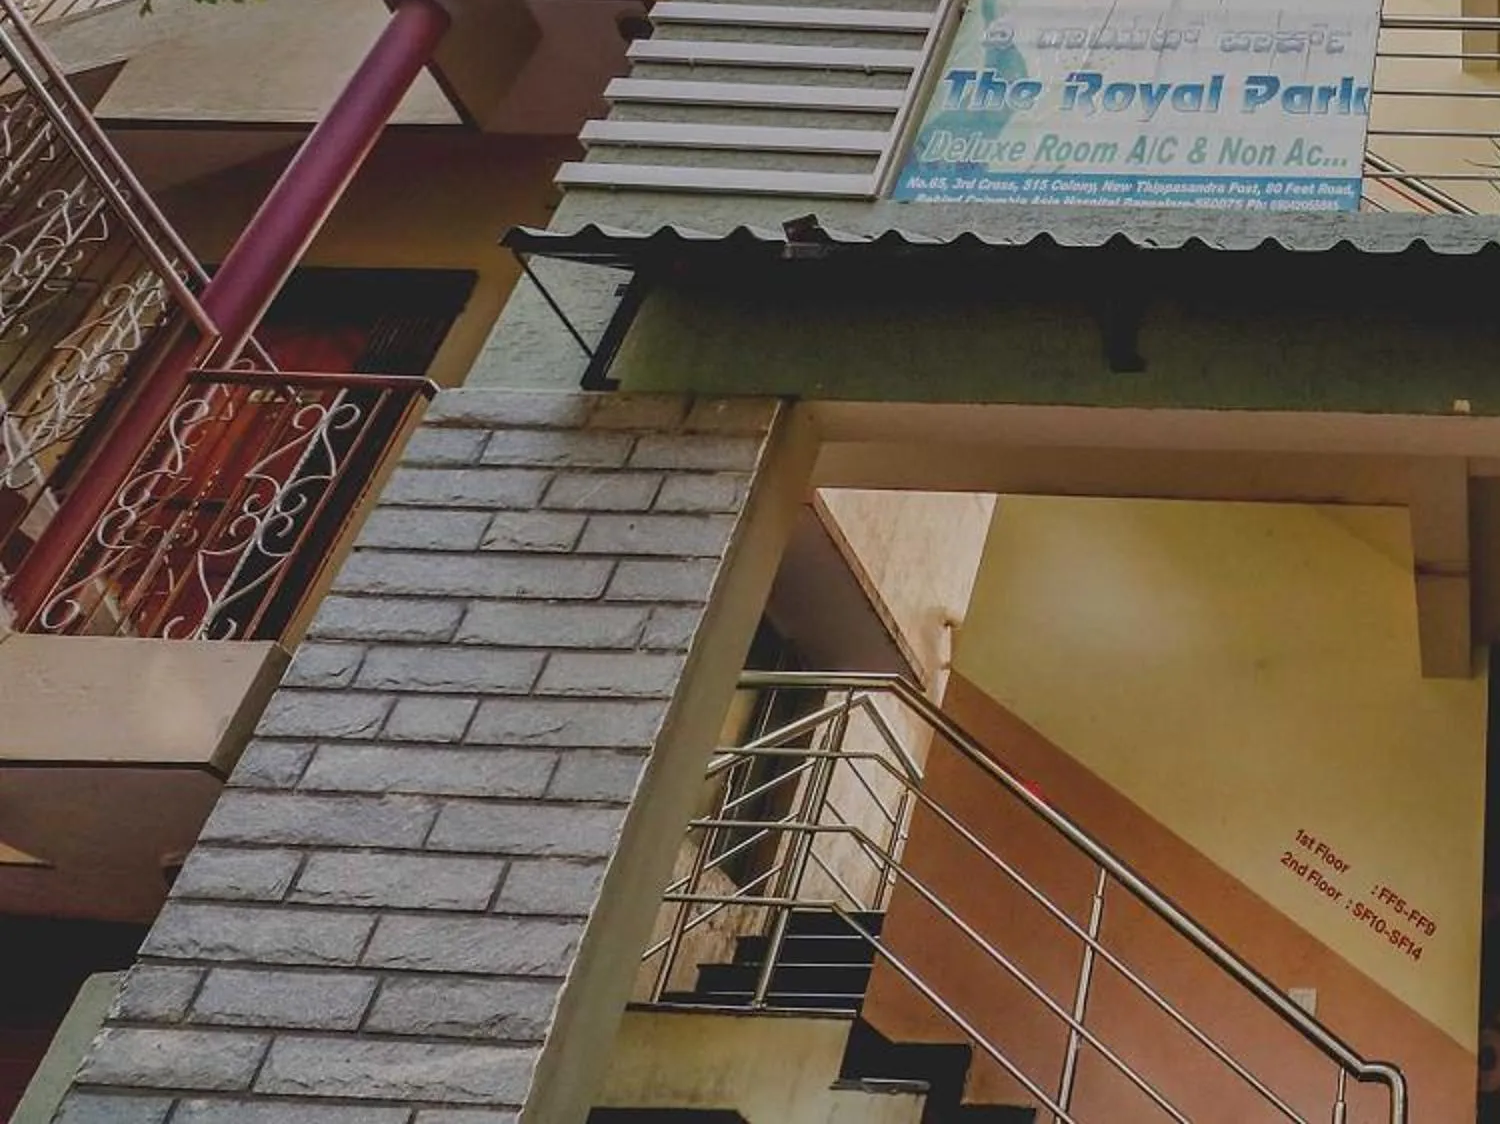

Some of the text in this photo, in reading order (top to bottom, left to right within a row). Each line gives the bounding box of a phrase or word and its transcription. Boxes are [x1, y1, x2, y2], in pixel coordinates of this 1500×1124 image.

[944, 69, 1042, 111] The
[1058, 71, 1226, 122] Royal
[921, 130, 1026, 163] Deluxe
[1034, 133, 1119, 163] Room
[1126, 135, 1178, 164] A/C
[1187, 137, 1208, 165] &
[1218, 137, 1277, 166] Non
[952, 177, 977, 189] 3rd
[1284, 182, 1316, 195] Feet
[1295, 828, 1316, 851] 1st
[1314, 843, 1351, 874] Floor
[1280, 851, 1309, 877] 2nd
[1307, 869, 1343, 902] Floor
